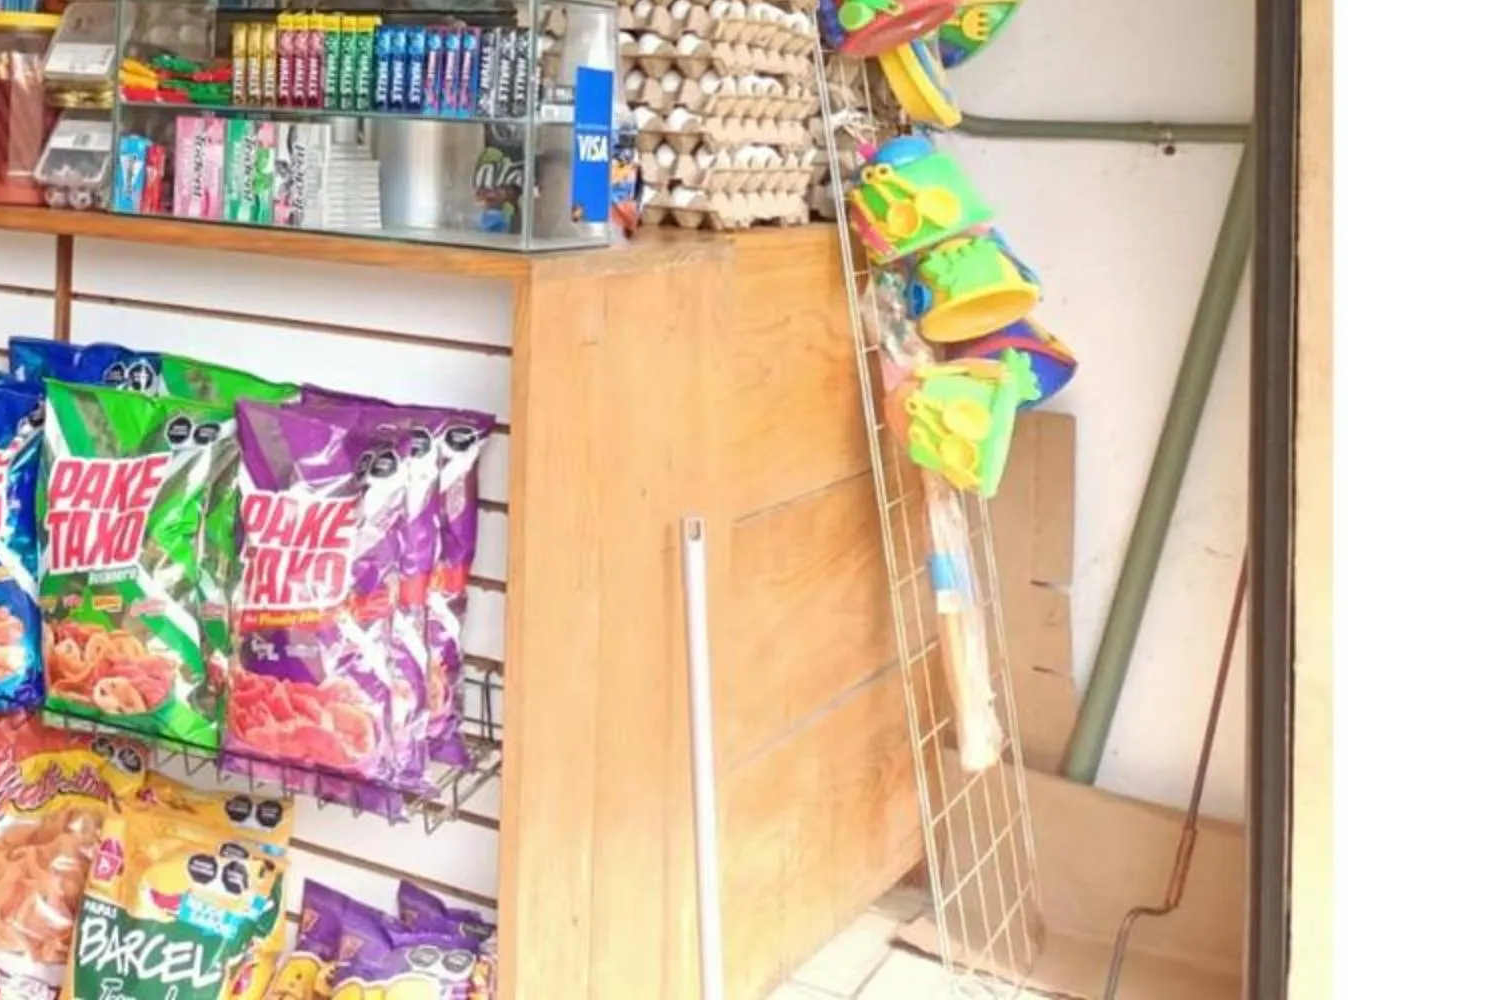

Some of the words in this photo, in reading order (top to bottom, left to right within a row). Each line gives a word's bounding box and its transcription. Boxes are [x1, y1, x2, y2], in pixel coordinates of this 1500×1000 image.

[578, 135, 609, 162] VISA
[49, 456, 169, 512] PAKE
[47, 509, 147, 570] TAXO
[243, 494, 358, 548] PAKE
[79, 917, 222, 987] BARCEL
